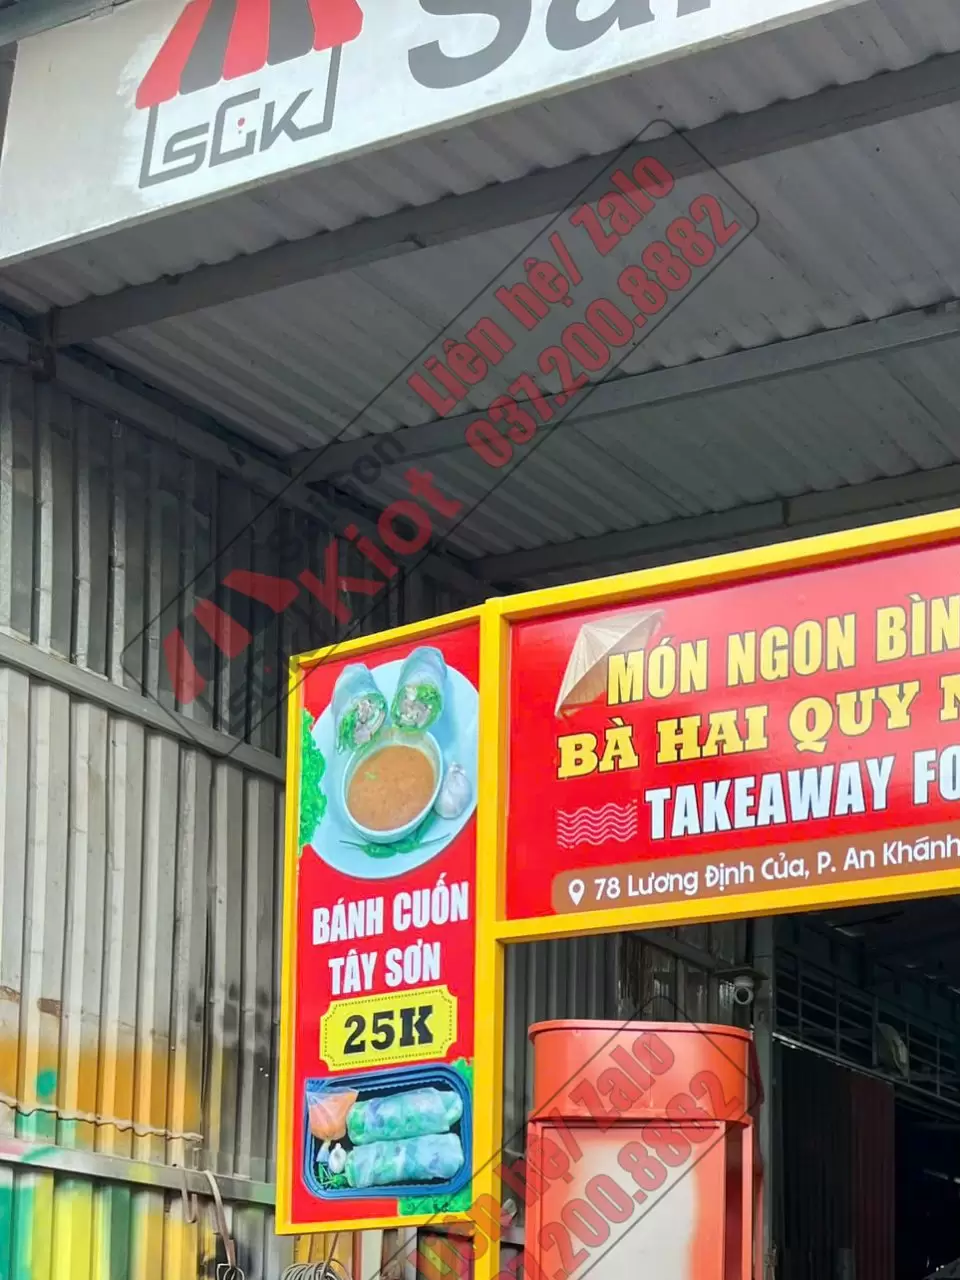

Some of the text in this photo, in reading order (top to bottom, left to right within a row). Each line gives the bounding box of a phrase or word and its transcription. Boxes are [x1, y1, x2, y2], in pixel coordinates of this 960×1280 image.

[606, 637, 708, 706] MÓN
[726, 613, 857, 687] NGON
[556, 717, 640, 779] BÀ
[656, 705, 768, 763] HAI
[788, 680, 921, 753] QUY
[645, 754, 895, 841] TAKEAWAY
[311, 872, 469, 945] BÁNH CUỐN
[594, 877, 621, 900] 78
[628, 870, 699, 897] Lương
[705, 861, 755, 892] Định
[761, 852, 809, 880] Của,
[817, 851, 837, 874] P.
[844, 847, 875, 871] An
[328, 939, 441, 995] TÂY SƠN
[343, 1005, 434, 1055] 25K
